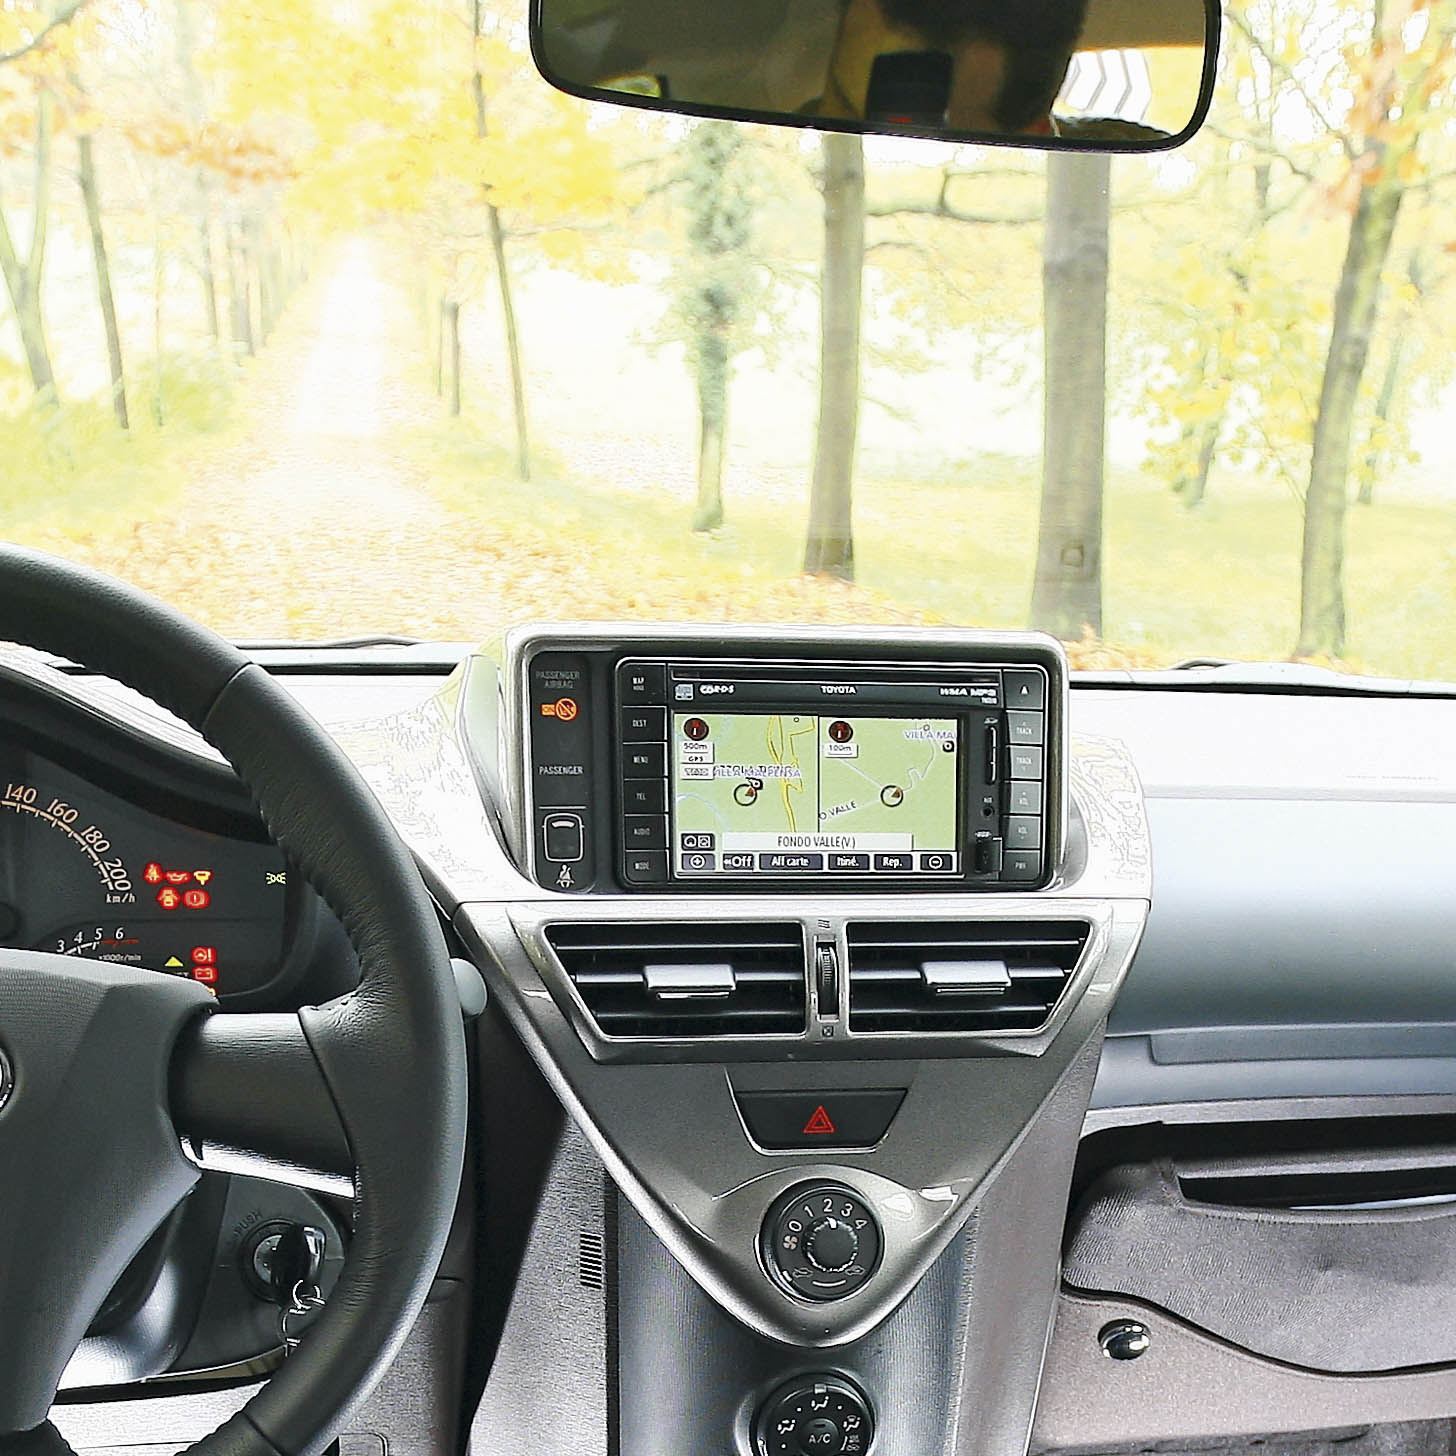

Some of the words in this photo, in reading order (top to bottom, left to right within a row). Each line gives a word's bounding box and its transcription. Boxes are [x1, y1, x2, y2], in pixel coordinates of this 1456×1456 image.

[821, 685, 856, 694] TOYOTA
[538, 766, 584, 775] PASSENGER
[5, 783, 37, 804] 140
[47, 798, 79, 824] 160
[80, 825, 110, 853] 180
[778, 836, 811, 847] FONDO
[104, 858, 132, 891] 200
[106, 893, 136, 903] km/h
[74, 931, 83, 943] 4
[95, 928, 103, 940] 5
[115, 927, 124, 939] 6
[57, 940, 65, 952] 3
[804, 1205, 814, 1217] 1
[823, 1198, 832, 1212] 2
[841, 1203, 853, 1216] 3
[789, 1220, 802, 1232] 0
[855, 1219, 867, 1229] 4
[809, 1433, 831, 1444] A/C
